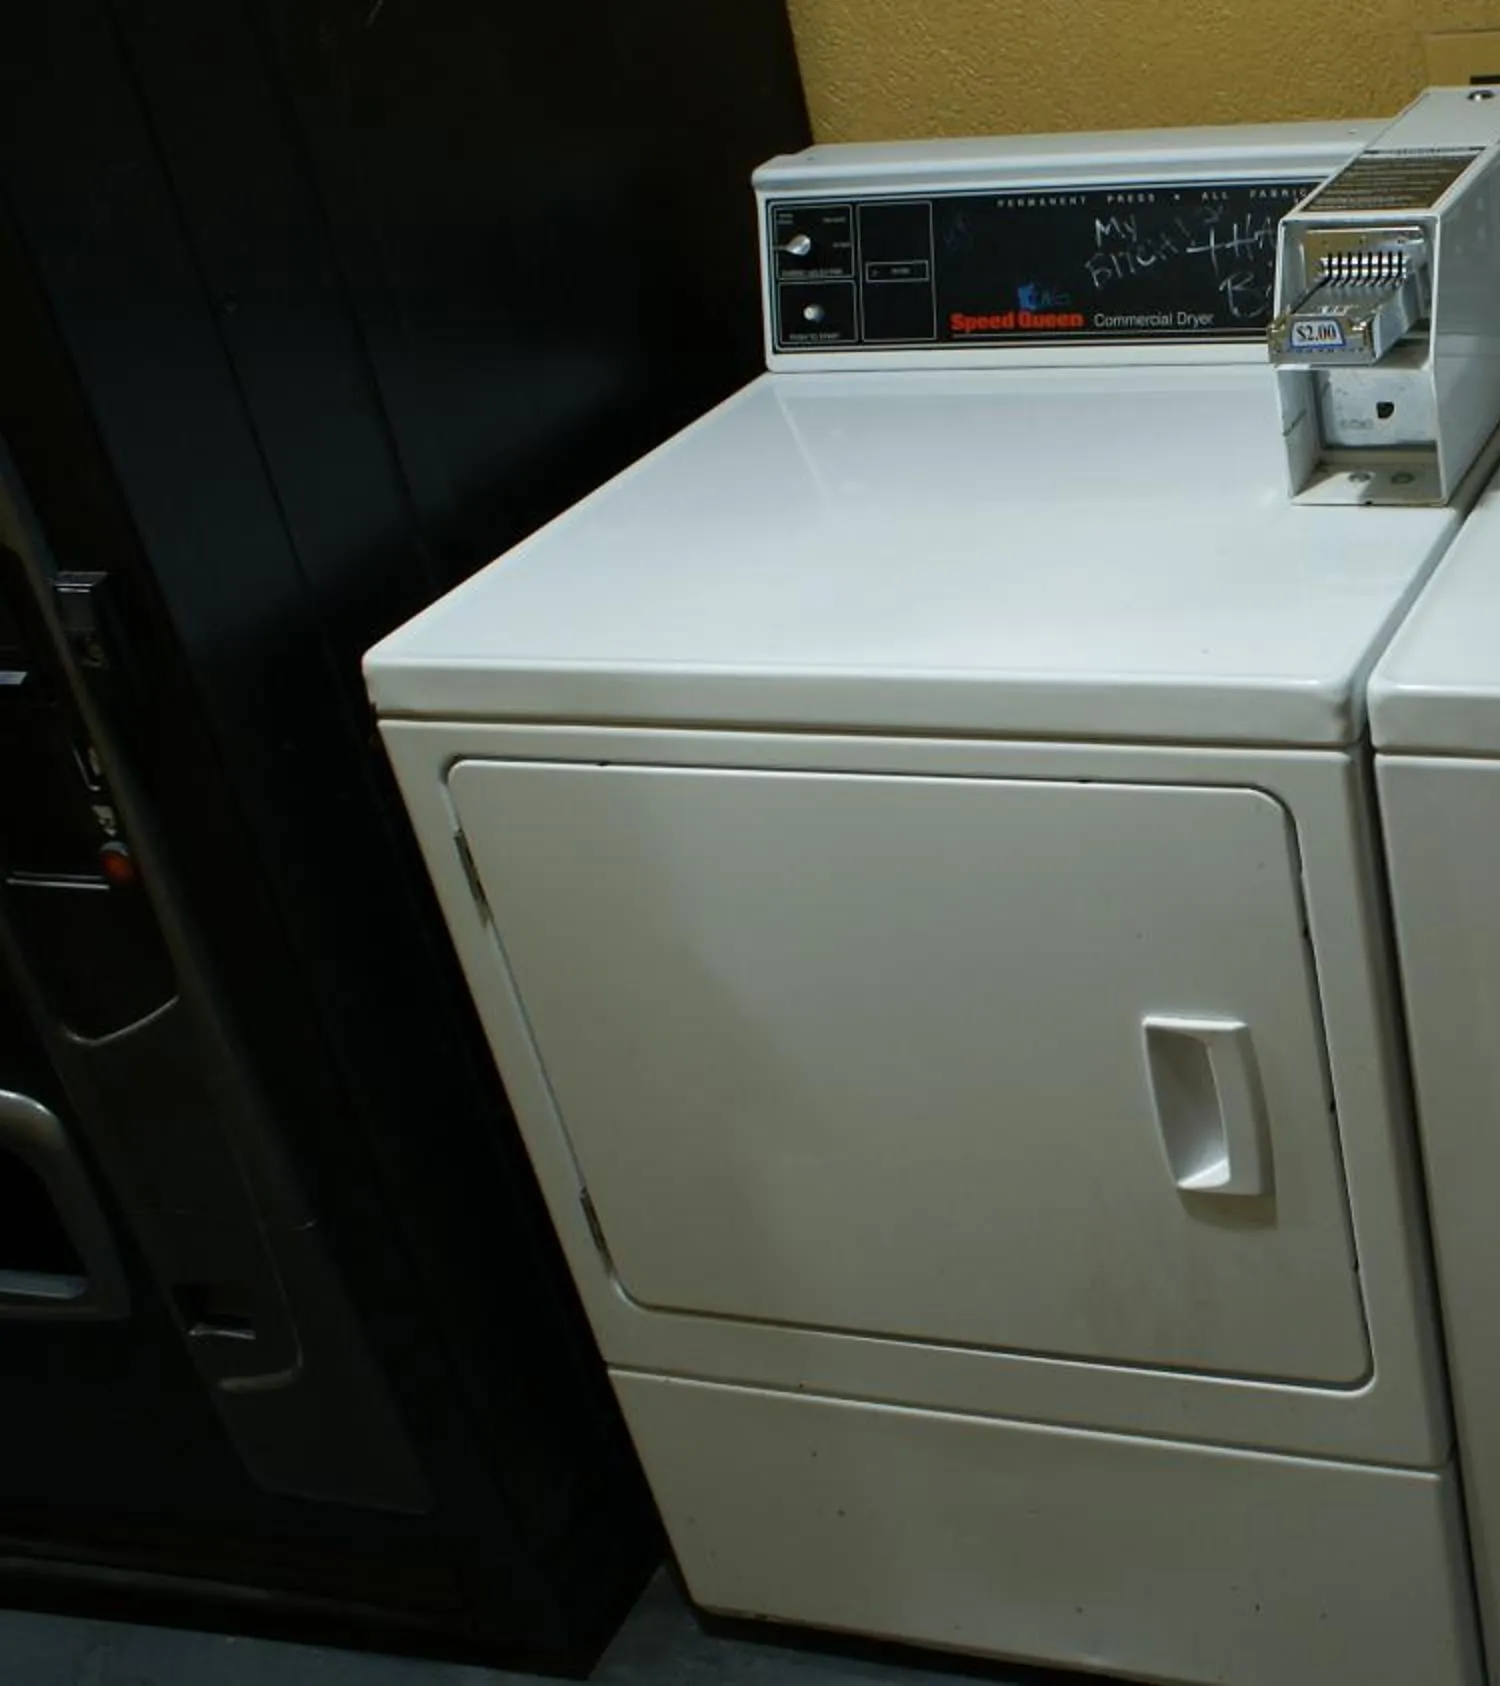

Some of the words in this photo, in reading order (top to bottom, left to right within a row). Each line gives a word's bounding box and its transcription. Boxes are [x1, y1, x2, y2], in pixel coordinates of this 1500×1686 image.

[997, 195, 1087, 208] PERMANENT
[1107, 193, 1156, 204] PRESS
[1202, 190, 1229, 201] ALL
[950, 311, 1014, 333] Speed
[1017, 310, 1085, 329] Queen
[1094, 312, 1173, 329] Commercial
[1177, 311, 1215, 330] Dryer
[1295, 323, 1338, 341] $2.00
